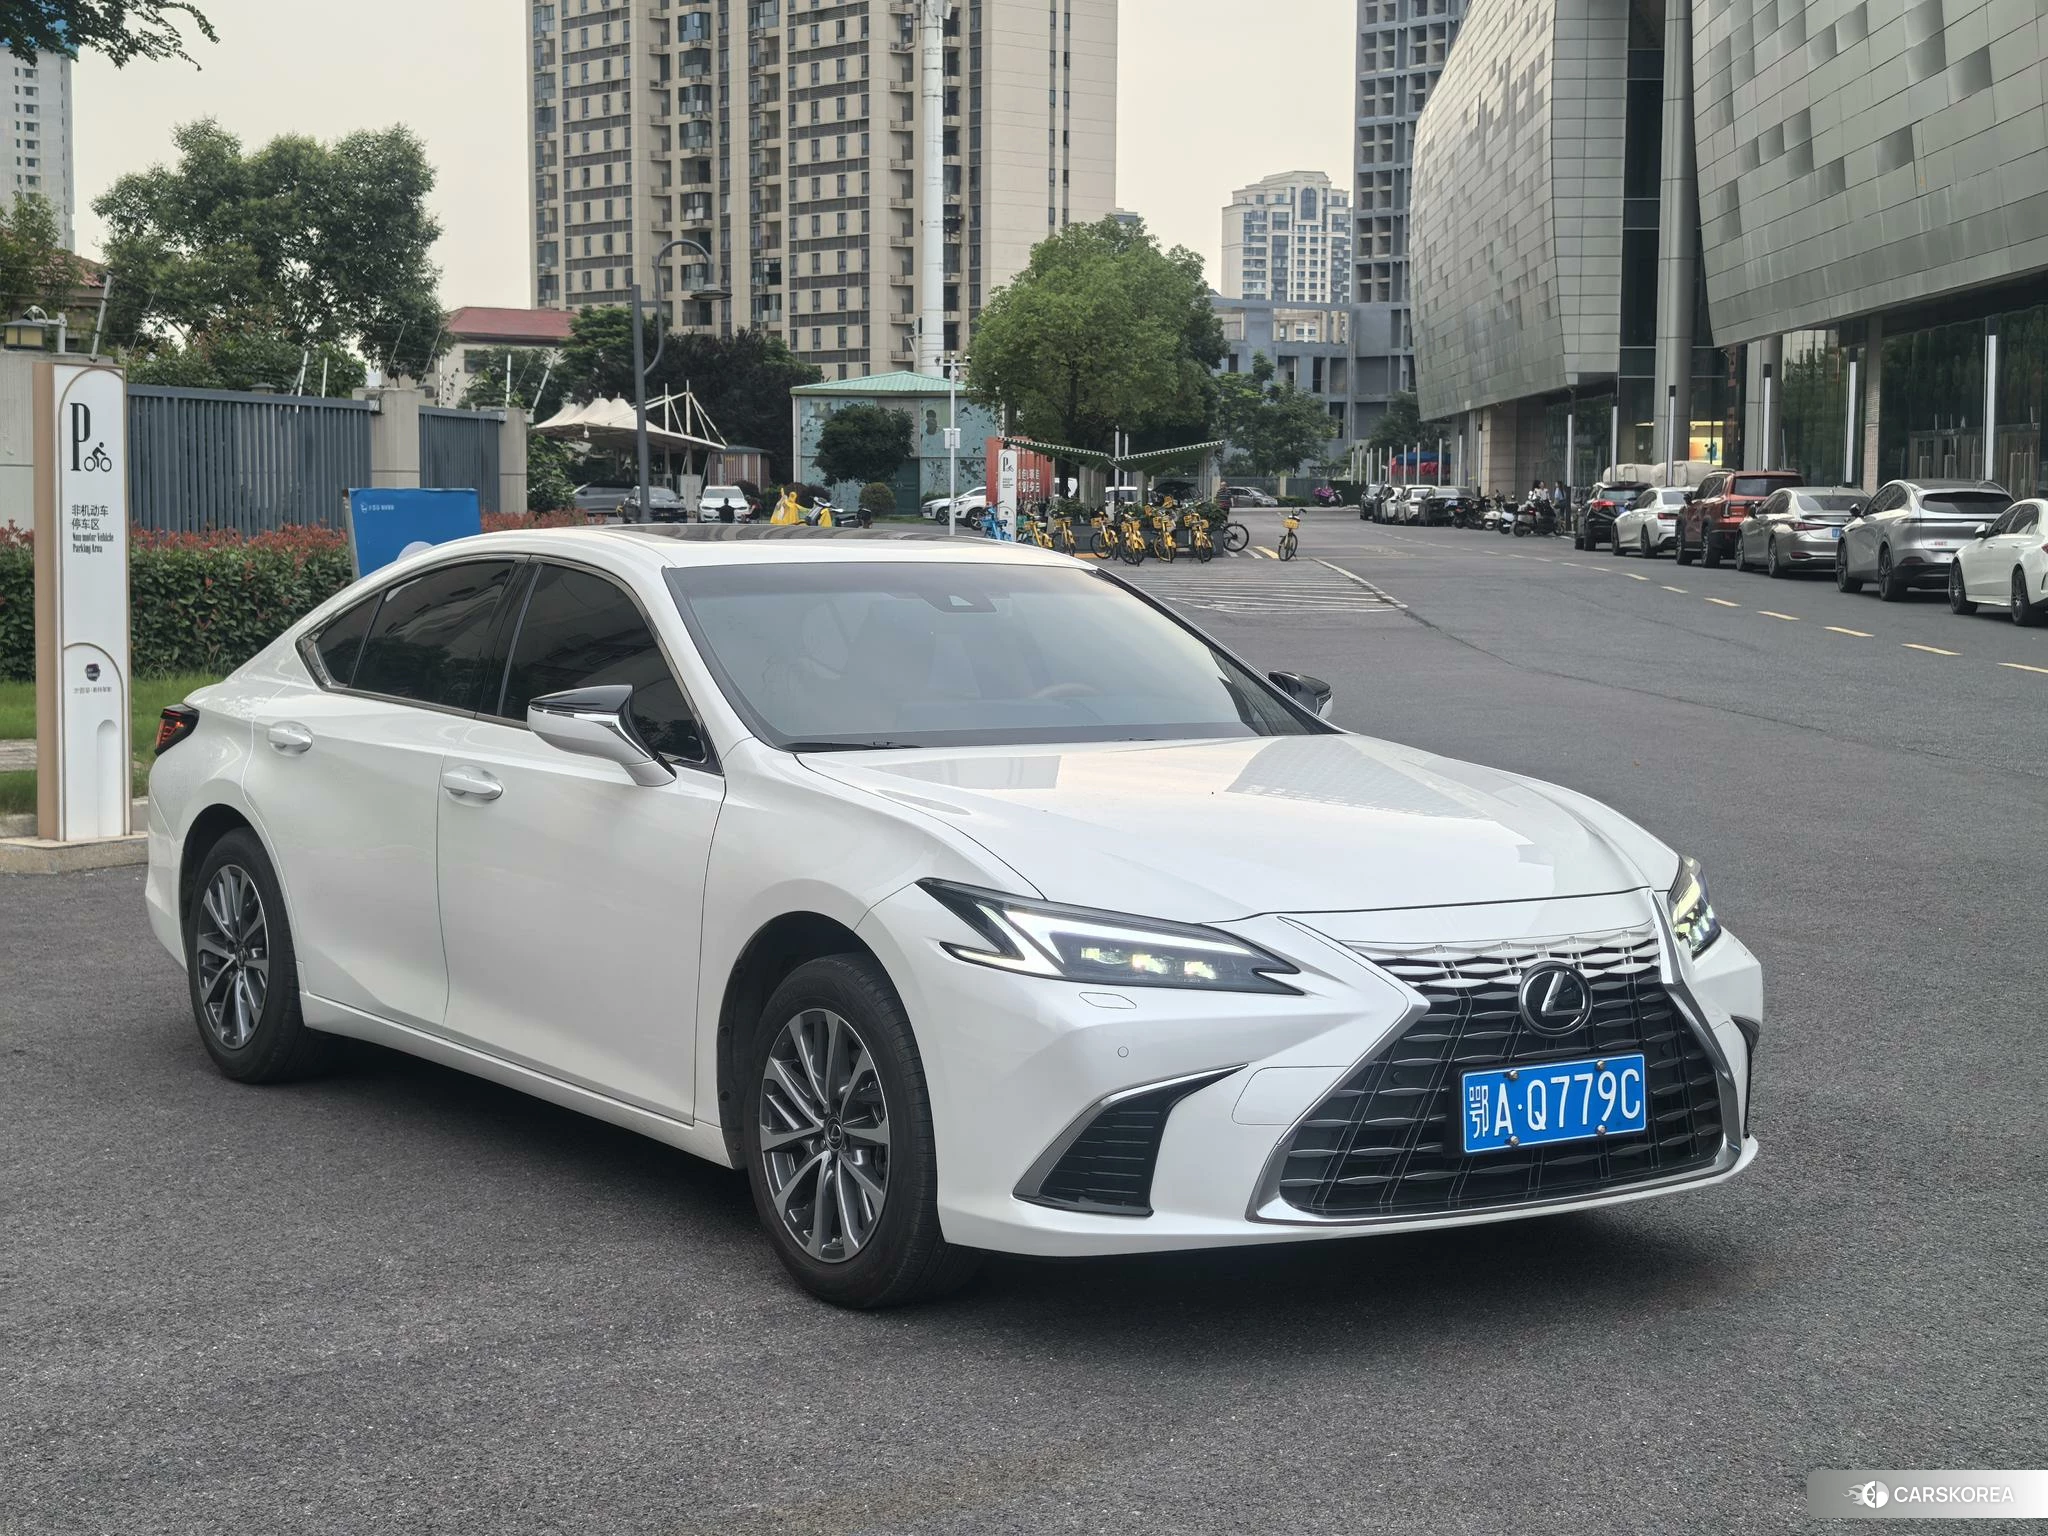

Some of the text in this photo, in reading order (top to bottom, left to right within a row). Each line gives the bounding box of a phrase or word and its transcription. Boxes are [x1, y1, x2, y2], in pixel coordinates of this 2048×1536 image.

[70, 403, 91, 471] P
[72, 504, 109, 517] 非机动车
[72, 518, 100, 530] 停车区
